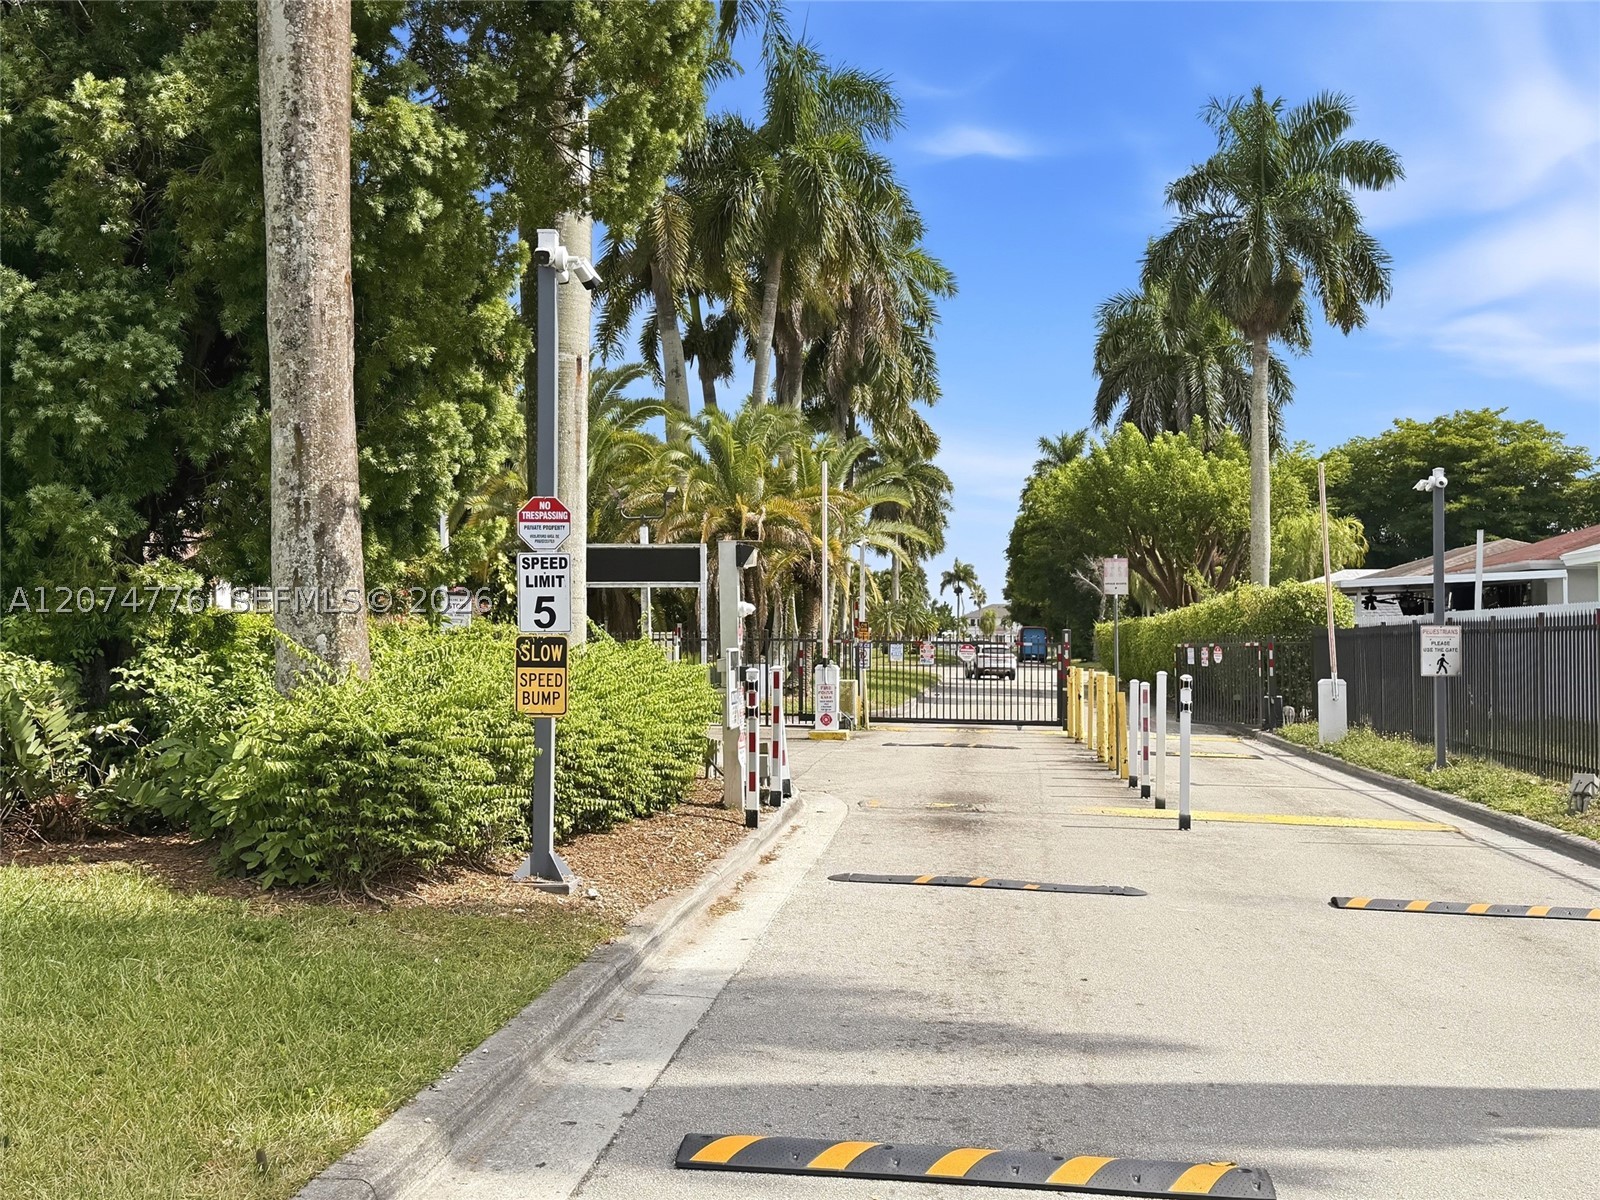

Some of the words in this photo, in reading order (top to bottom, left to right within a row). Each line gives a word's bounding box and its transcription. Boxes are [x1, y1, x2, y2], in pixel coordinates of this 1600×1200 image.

[539, 501, 551, 510] NO
[521, 511, 568, 520] TRESPASSING
[521, 556, 568, 570] SPEED
[525, 575, 565, 588] LIMIT
[534, 596, 556, 629] 5
[520, 644, 563, 662] SLOW
[519, 672, 563, 688] SPEED
[522, 691, 561, 706] BUMP
